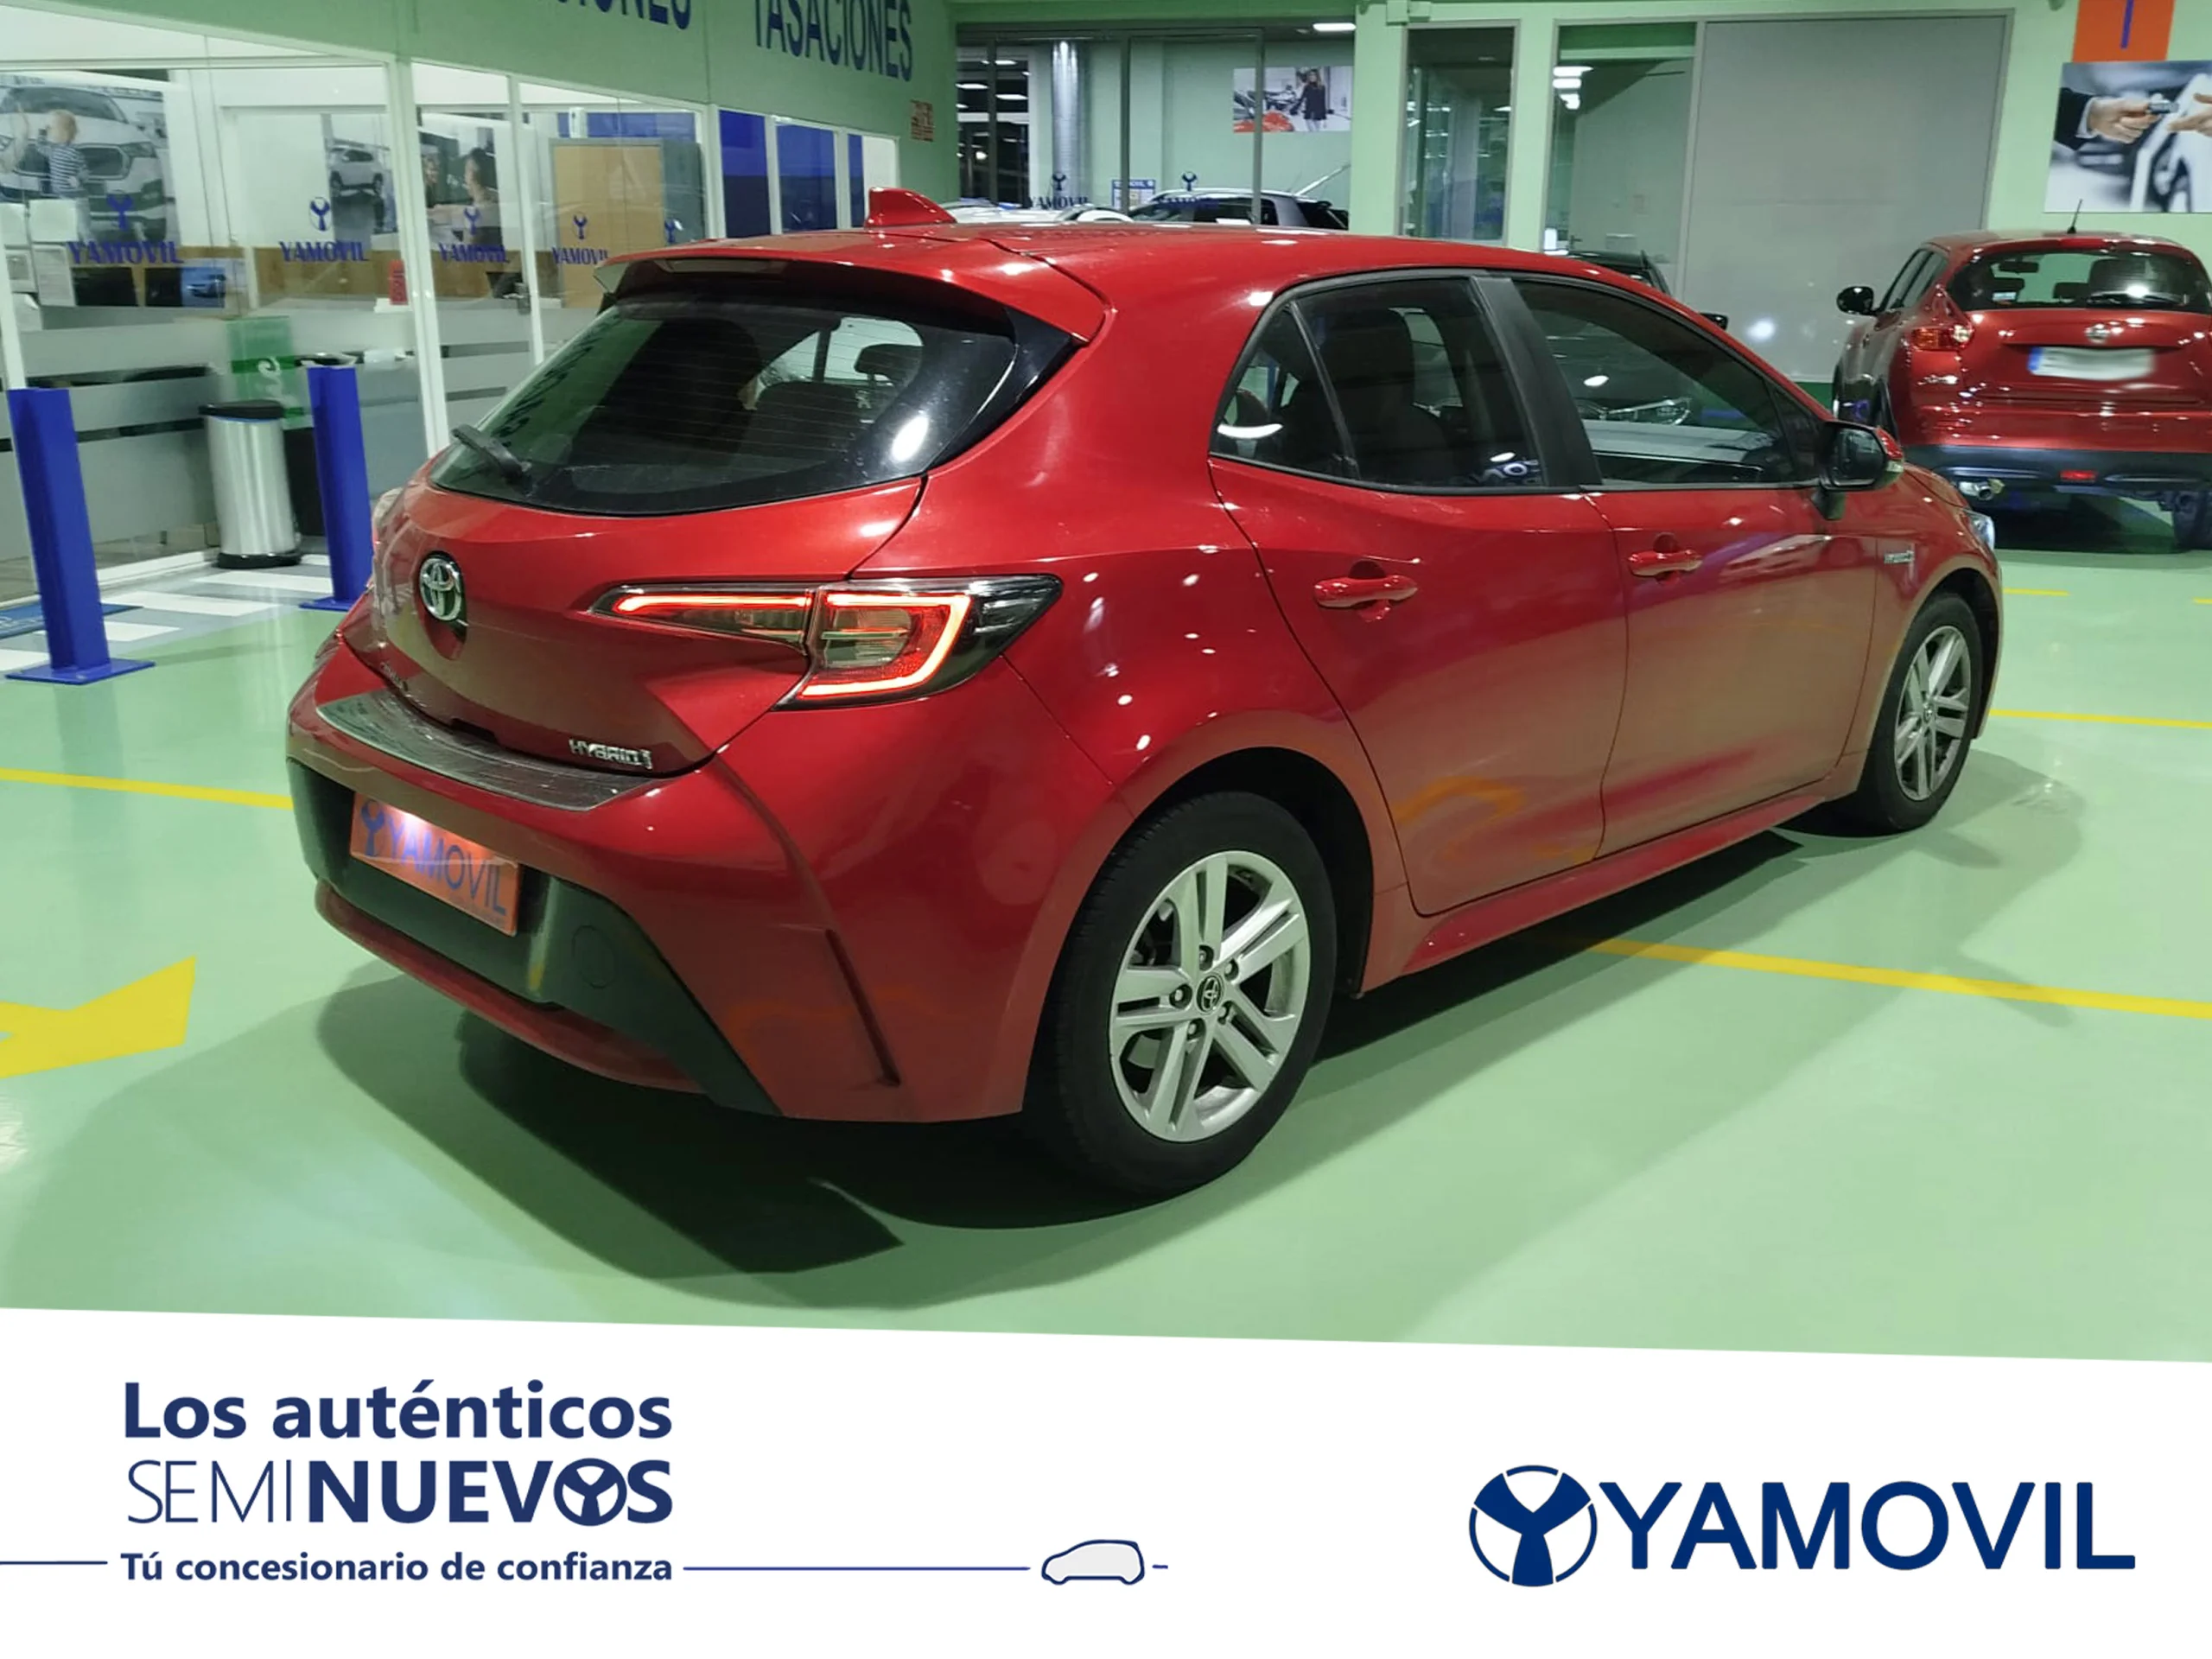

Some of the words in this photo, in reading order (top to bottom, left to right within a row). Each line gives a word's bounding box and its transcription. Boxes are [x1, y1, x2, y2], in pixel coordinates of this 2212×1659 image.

[67, 242, 185, 264] YAMOVIL
[279, 242, 368, 263] YAMOVIL
[439, 243, 510, 263] YAMOVIL
[385, 817, 508, 915] YAMOVIL
